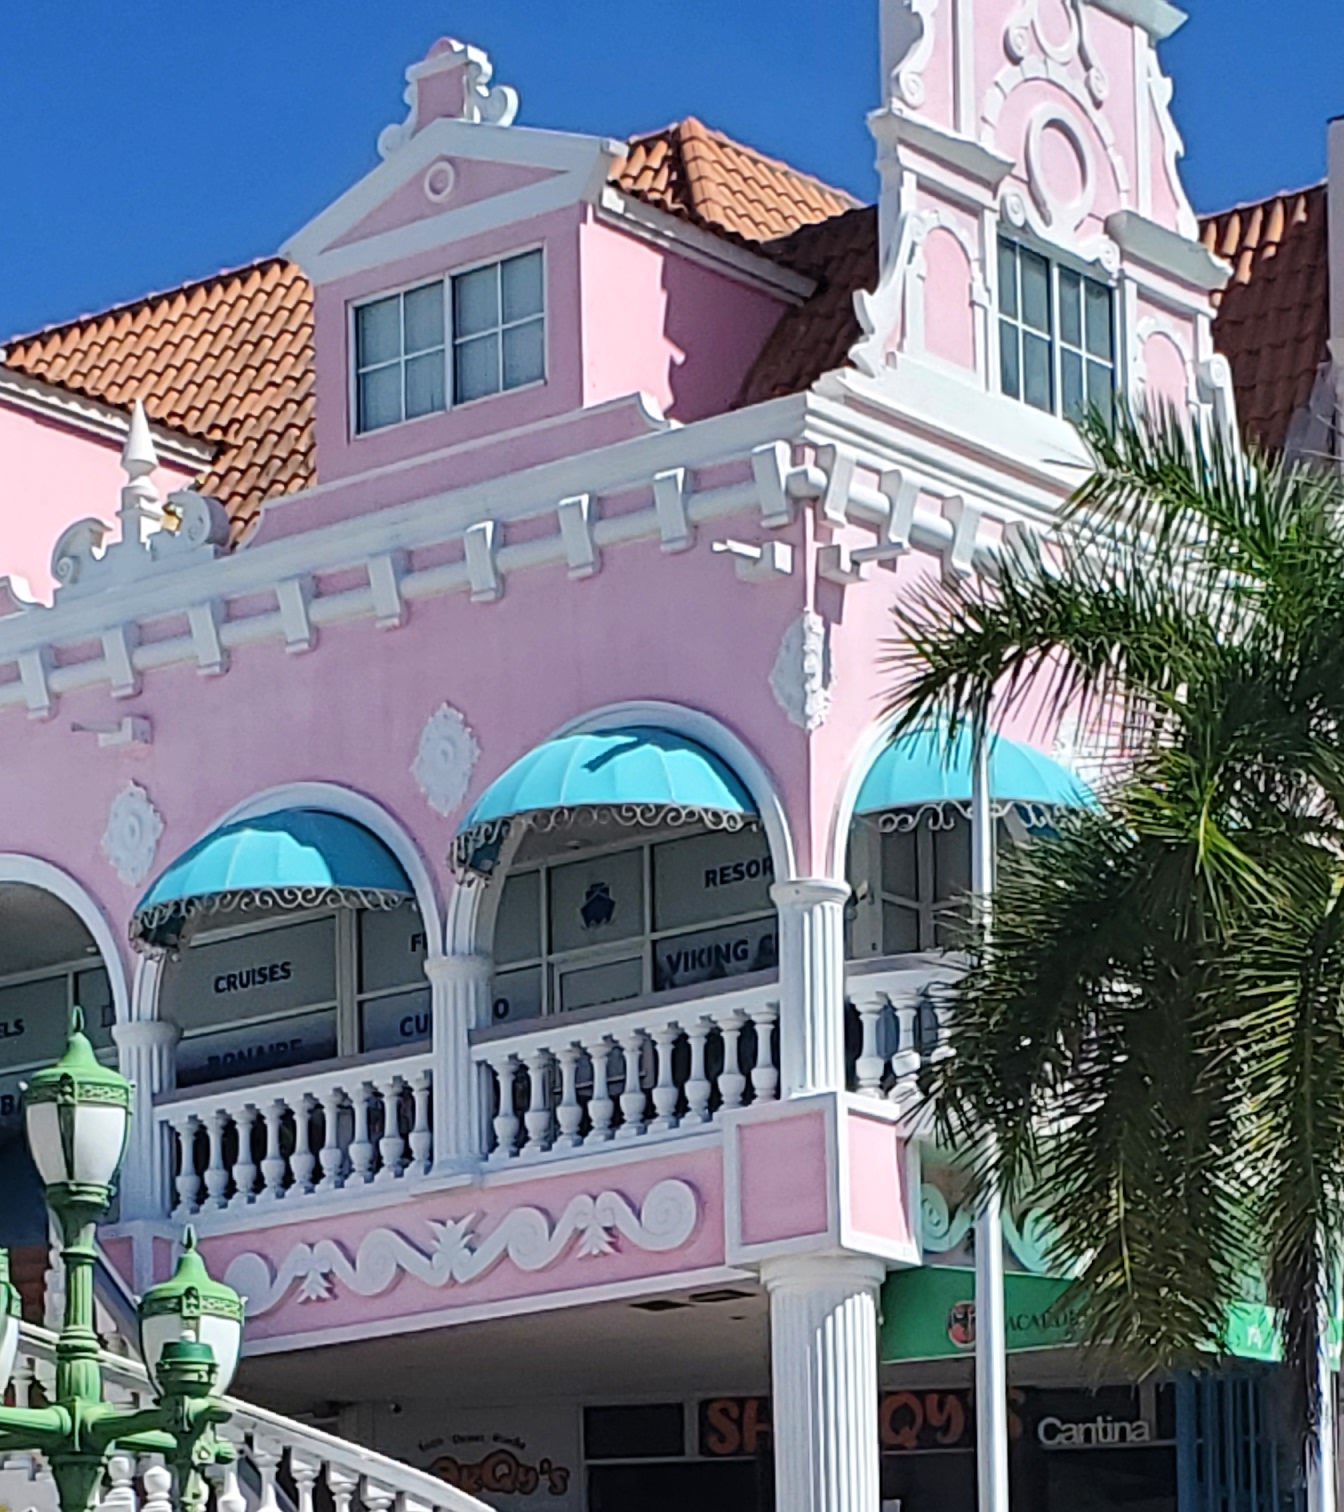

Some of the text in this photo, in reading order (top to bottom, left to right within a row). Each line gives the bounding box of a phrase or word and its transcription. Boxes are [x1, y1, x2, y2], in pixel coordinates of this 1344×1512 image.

[704, 857, 775, 890] RESOR
[665, 938, 750, 977] VIKING
[214, 961, 292, 993] CRUISES
[1037, 1415, 1151, 1446] Cantina
